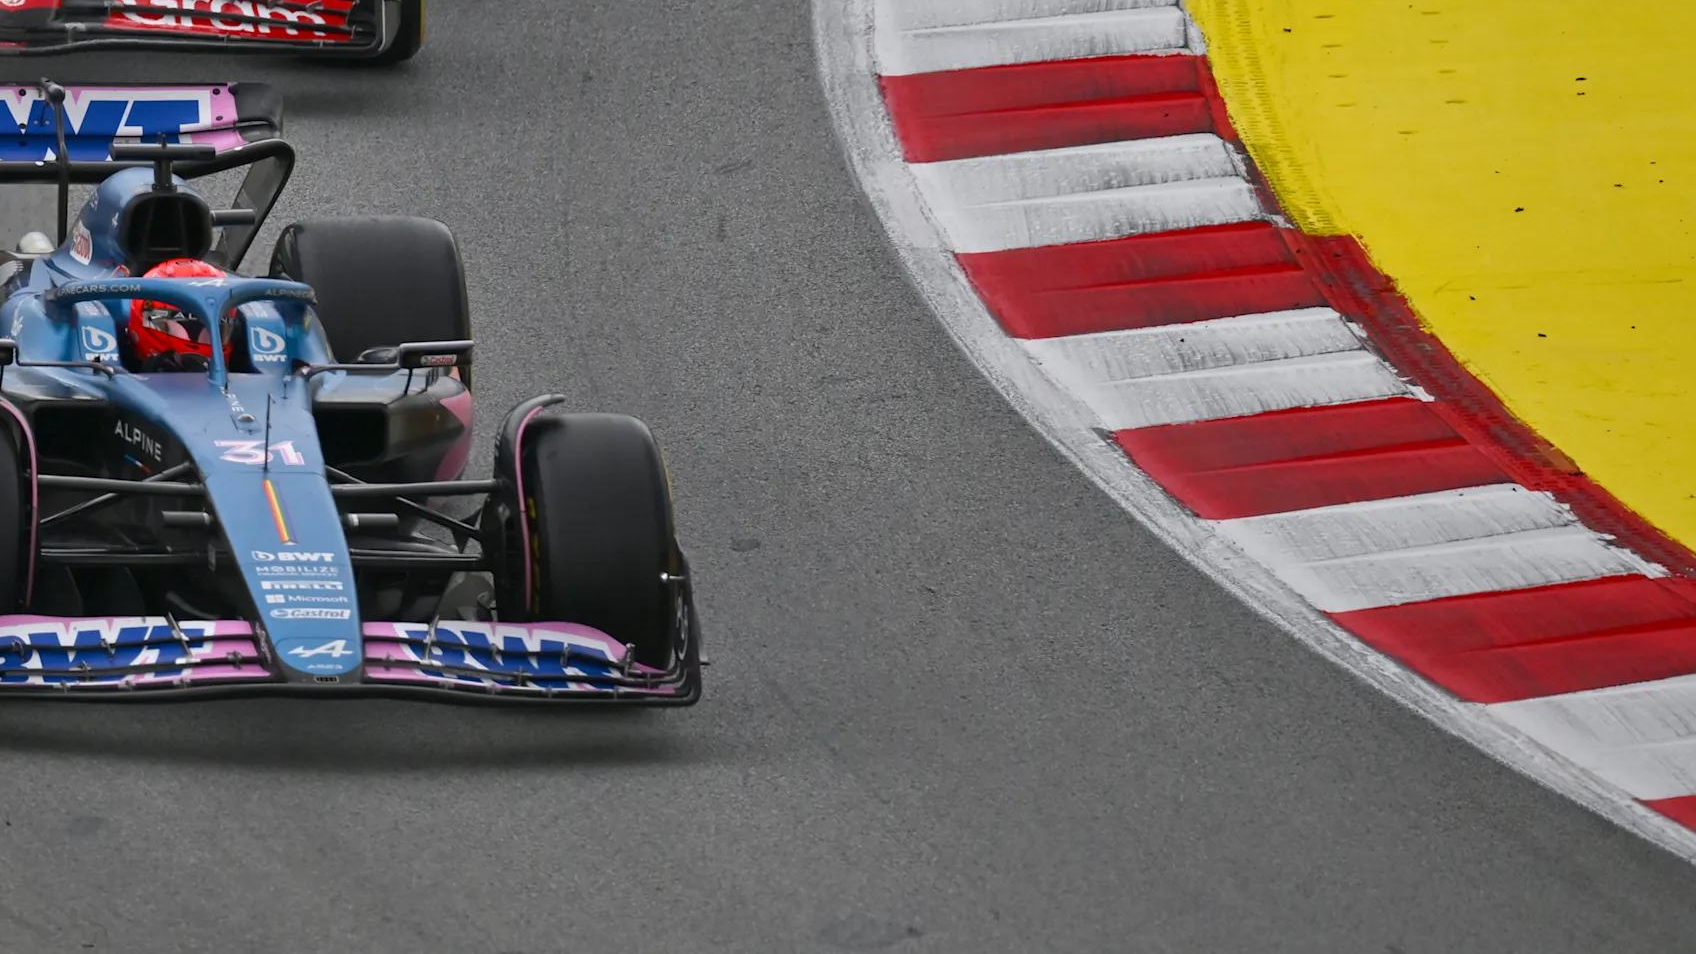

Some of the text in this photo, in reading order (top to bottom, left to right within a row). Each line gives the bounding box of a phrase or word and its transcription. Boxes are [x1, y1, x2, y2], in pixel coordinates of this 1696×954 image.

[253, 353, 287, 363] BWT
[115, 419, 161, 462] ALPINE
[214, 440, 305, 466] 31
[277, 552, 335, 562] BWT
[261, 581, 343, 591] PIRELLI
[288, 595, 348, 603] Microsoft
[291, 609, 346, 618] Castrol
[404, 629, 623, 691] BWT
